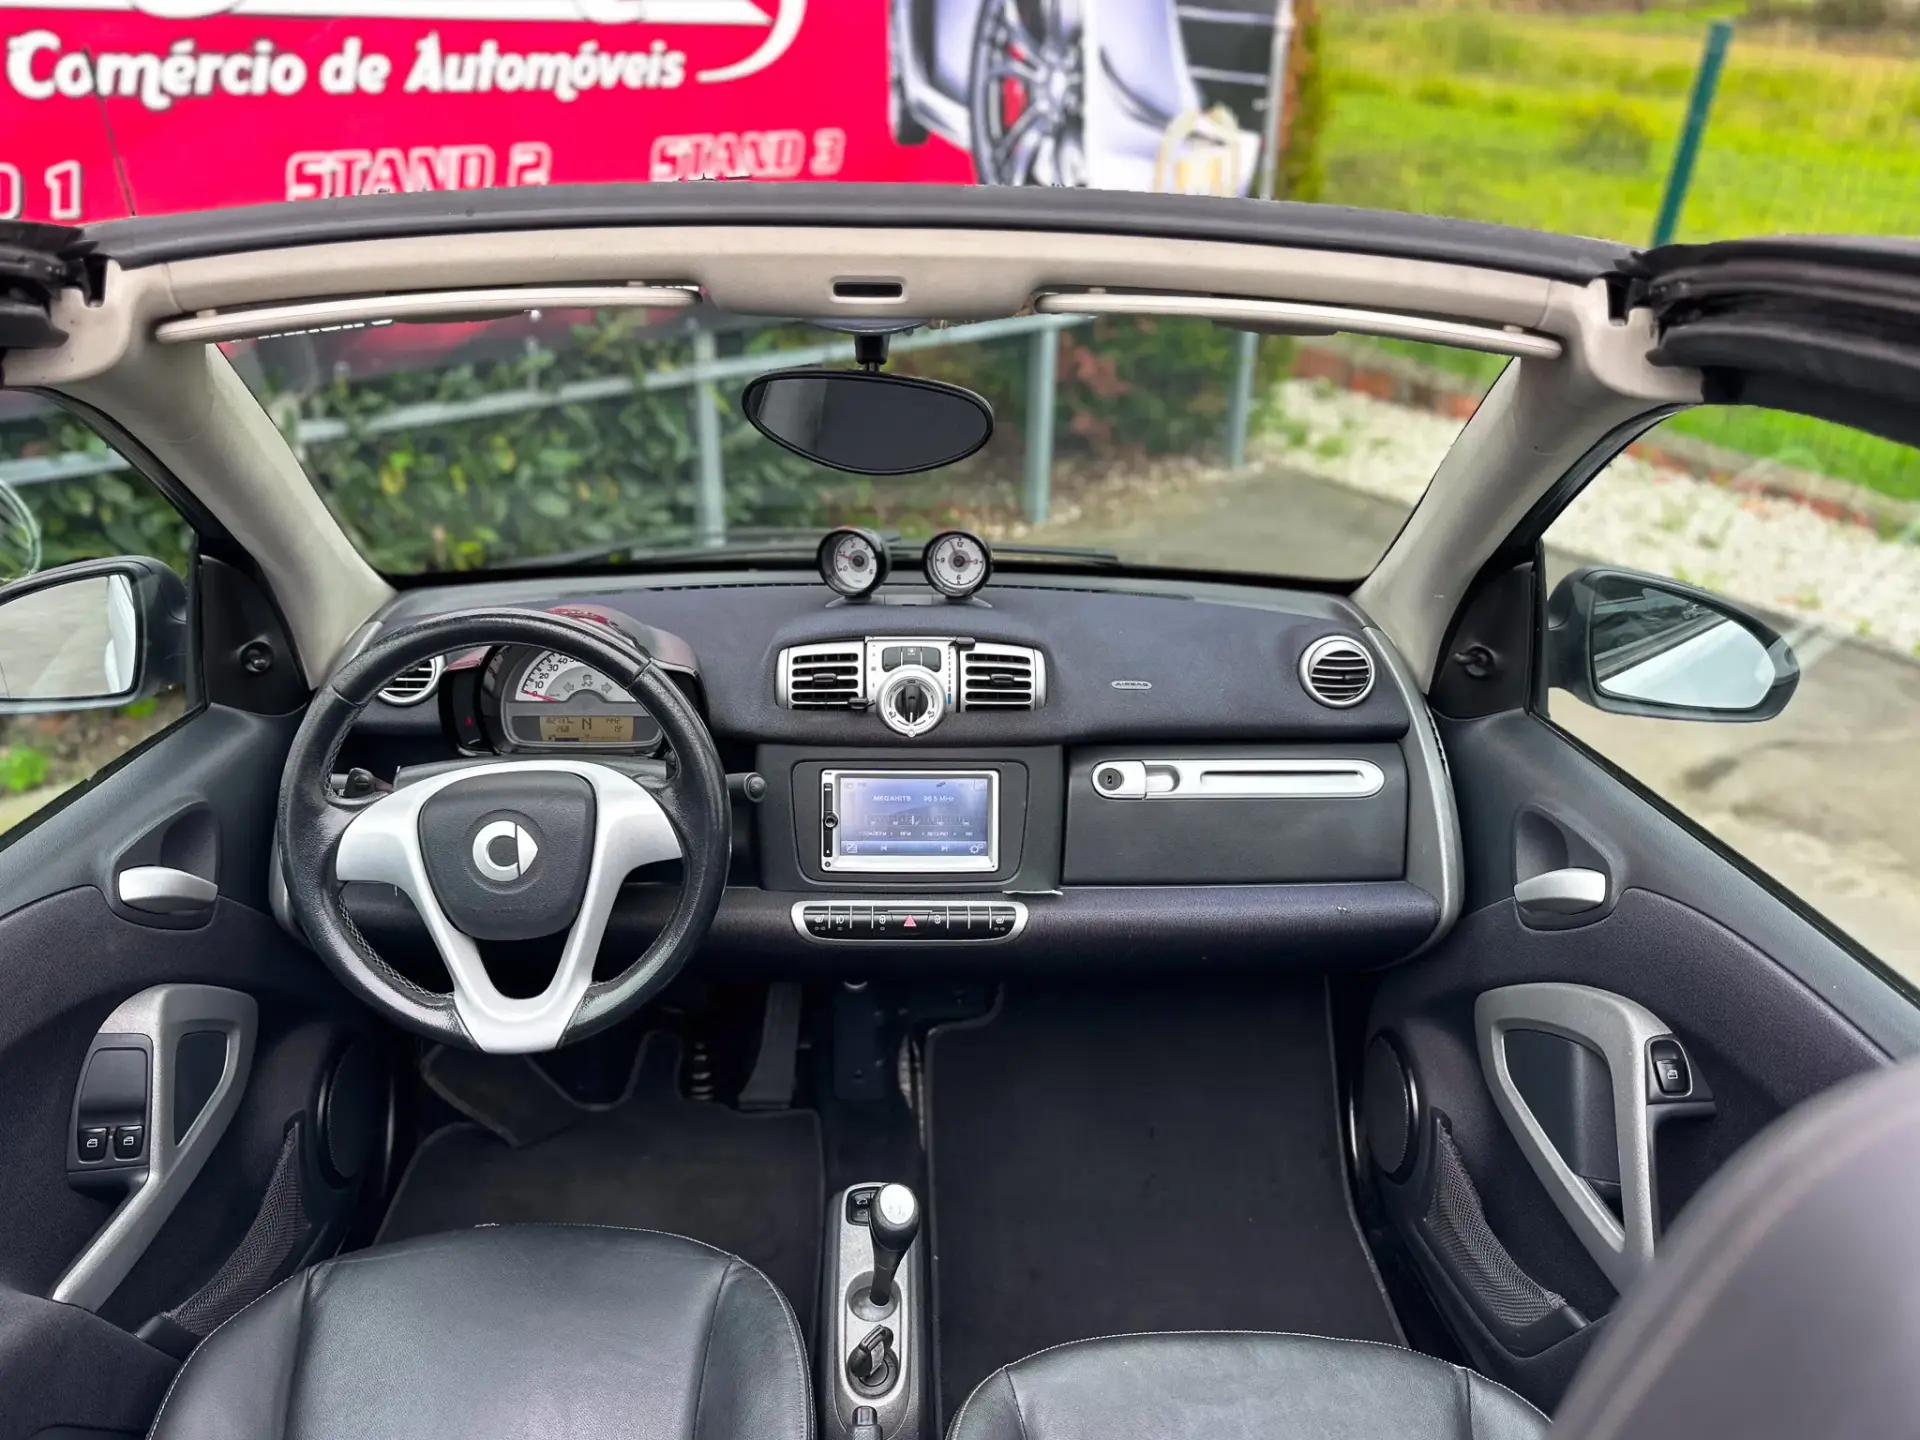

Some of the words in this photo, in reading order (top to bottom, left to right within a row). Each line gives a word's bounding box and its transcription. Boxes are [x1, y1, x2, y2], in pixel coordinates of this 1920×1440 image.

[6, 29, 307, 112] Comércio
[319, 36, 392, 95] de
[403, 31, 686, 102] Automóveis
[649, 130, 806, 182] STAND
[813, 127, 846, 177] 3
[285, 147, 495, 201] STAND
[508, 142, 552, 188] 2
[45, 159, 82, 220] 1
[557, 657, 568, 665] 40
[547, 664, 559, 672] 30
[539, 672, 550, 680] 20
[534, 681, 544, 689] 10
[581, 717, 592, 730] N
